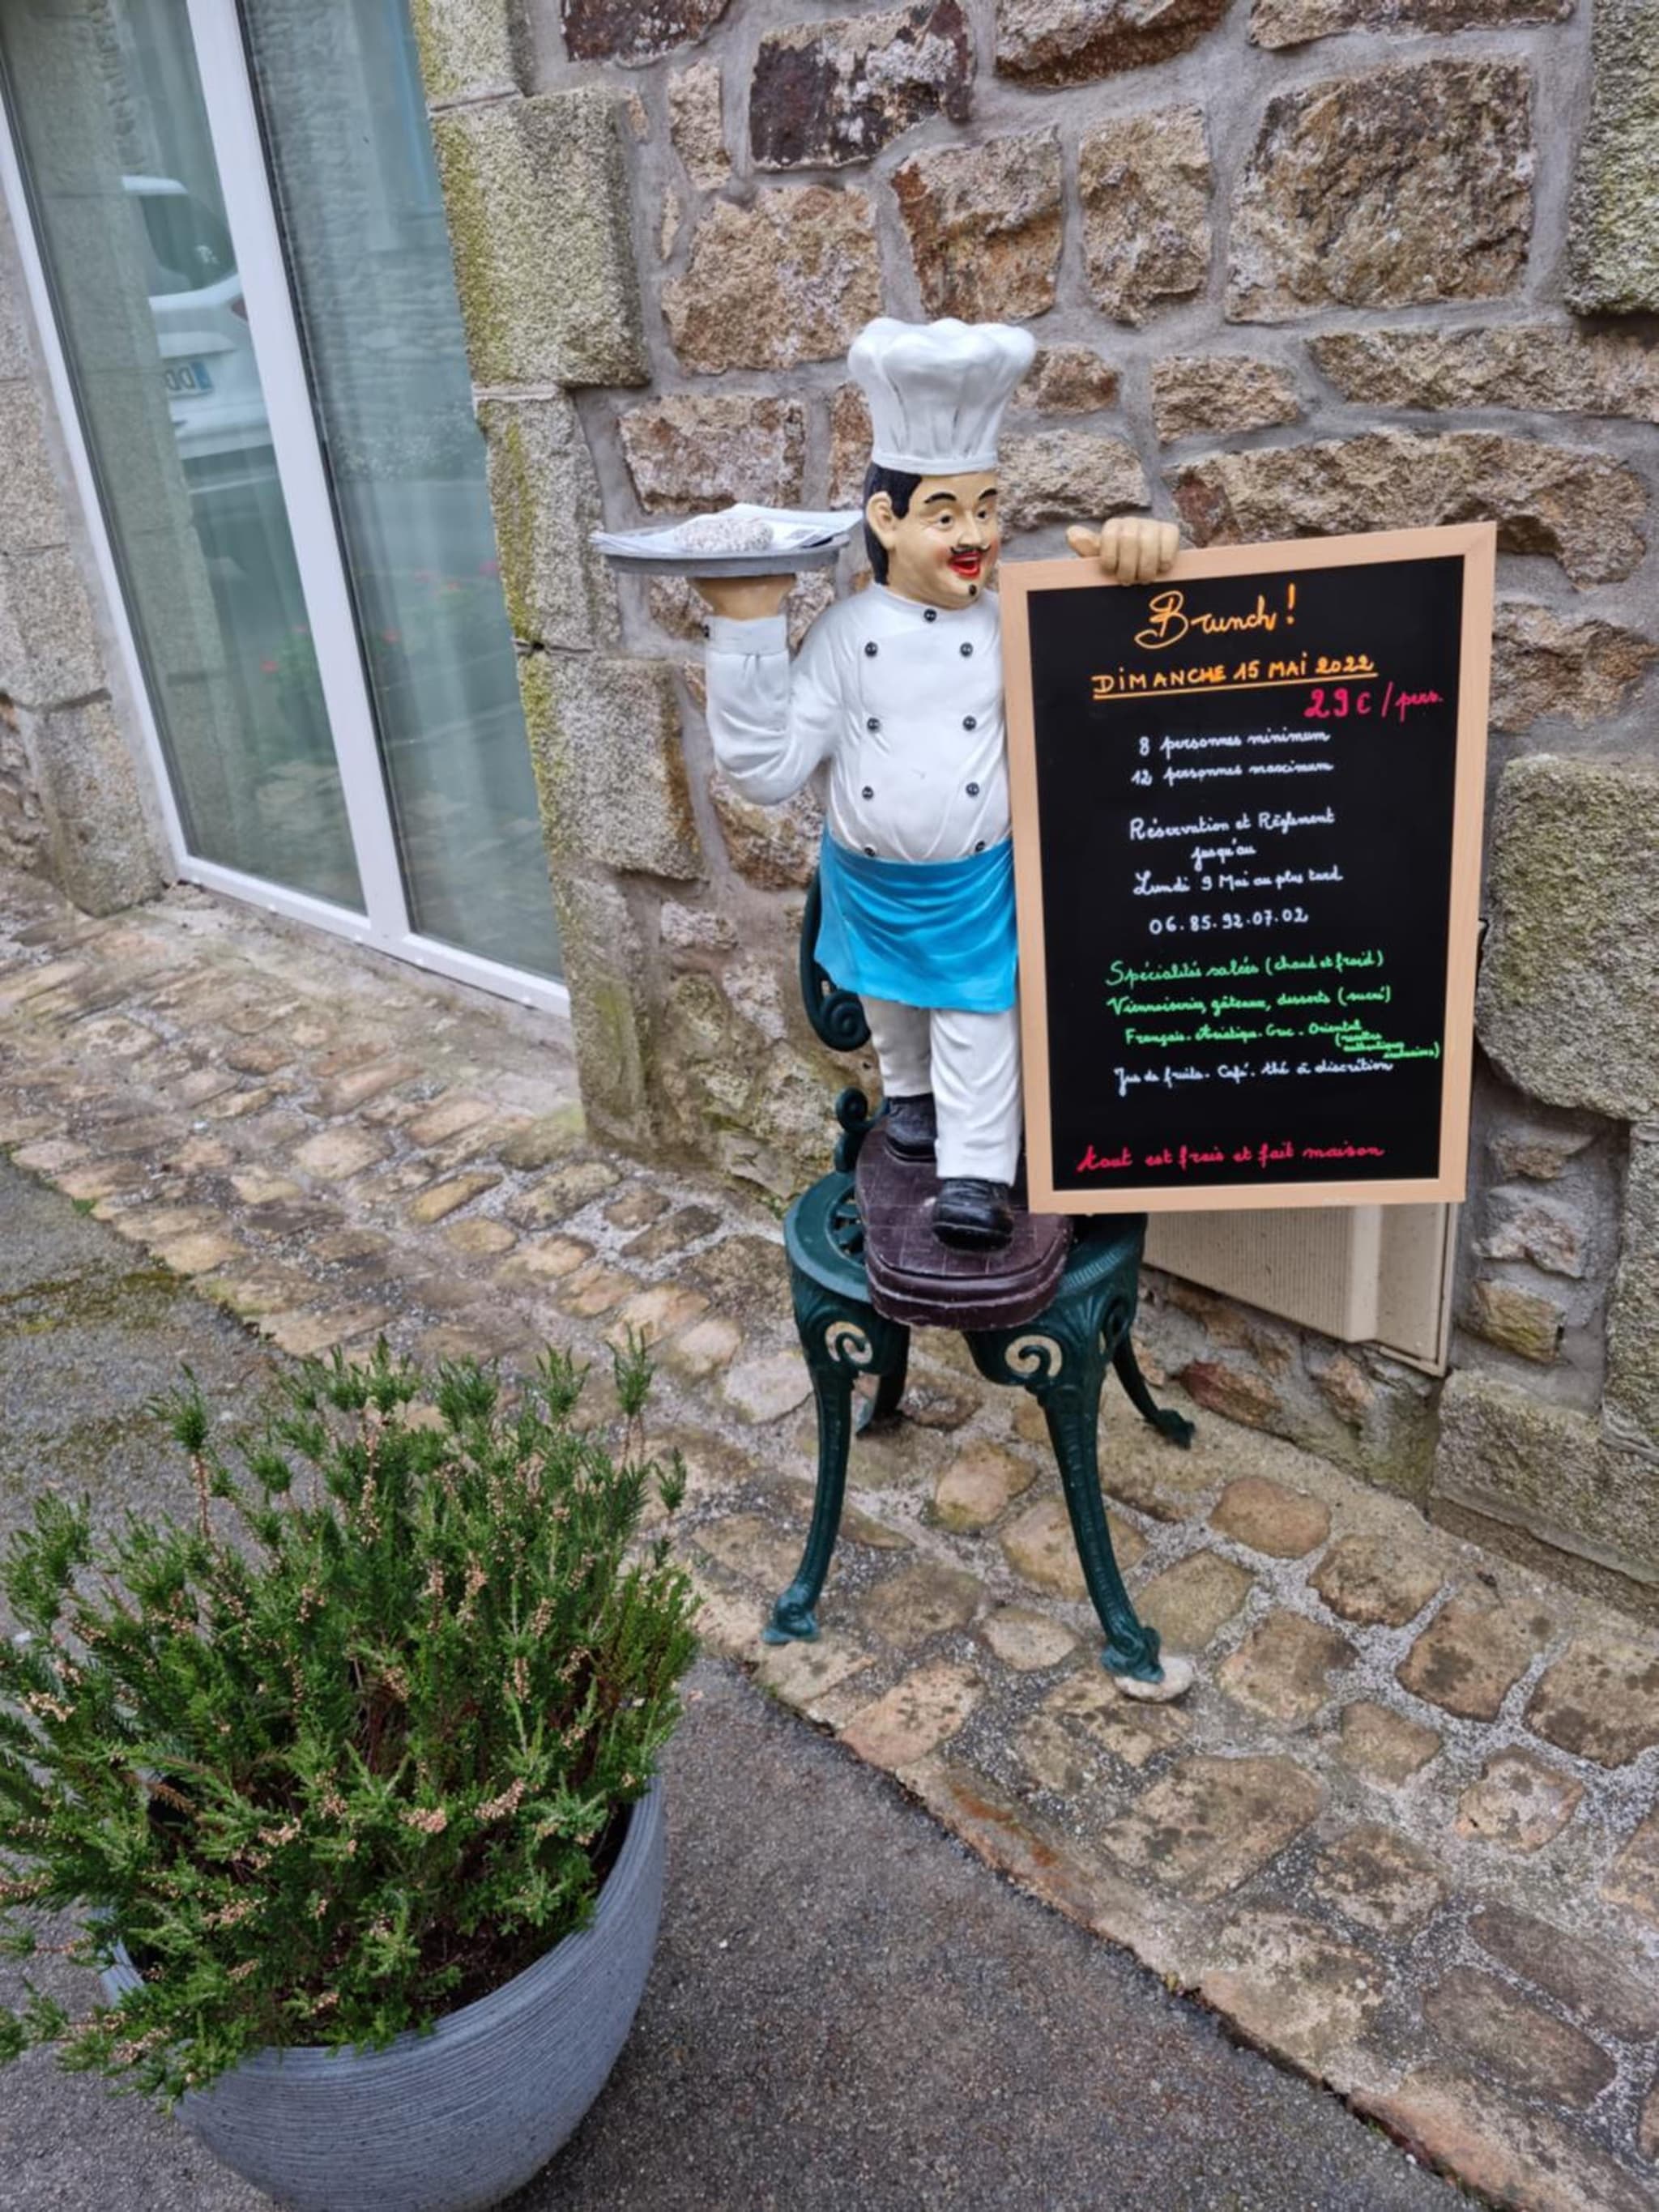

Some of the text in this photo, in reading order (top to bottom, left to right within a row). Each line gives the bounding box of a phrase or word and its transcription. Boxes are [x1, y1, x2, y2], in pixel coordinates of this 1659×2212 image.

[1133, 590, 1277, 650] Brunch
[1233, 658, 1260, 680] 15
[1314, 653, 1375, 672] 2022
[1138, 726, 1331, 761] 8 personnes minimum
[1130, 769, 1154, 786] 12
[1162, 764, 1243, 787] personnes
[1129, 816, 1230, 841] Réservation
[1235, 812, 1252, 830] et
[1132, 869, 1191, 896] Lundi
[1201, 875, 1213, 891] 9
[1218, 870, 1250, 892] Mai
[1274, 869, 1304, 890] plus
[1307, 864, 1344, 882] tard
[1106, 960, 1202, 988] Spécialités
[1145, 1149, 1173, 1166] est
[1179, 1145, 1225, 1170] frais
[1233, 1146, 1252, 1162] et
[1258, 1141, 1294, 1168] fait
[1301, 1141, 1386, 1159] maison
